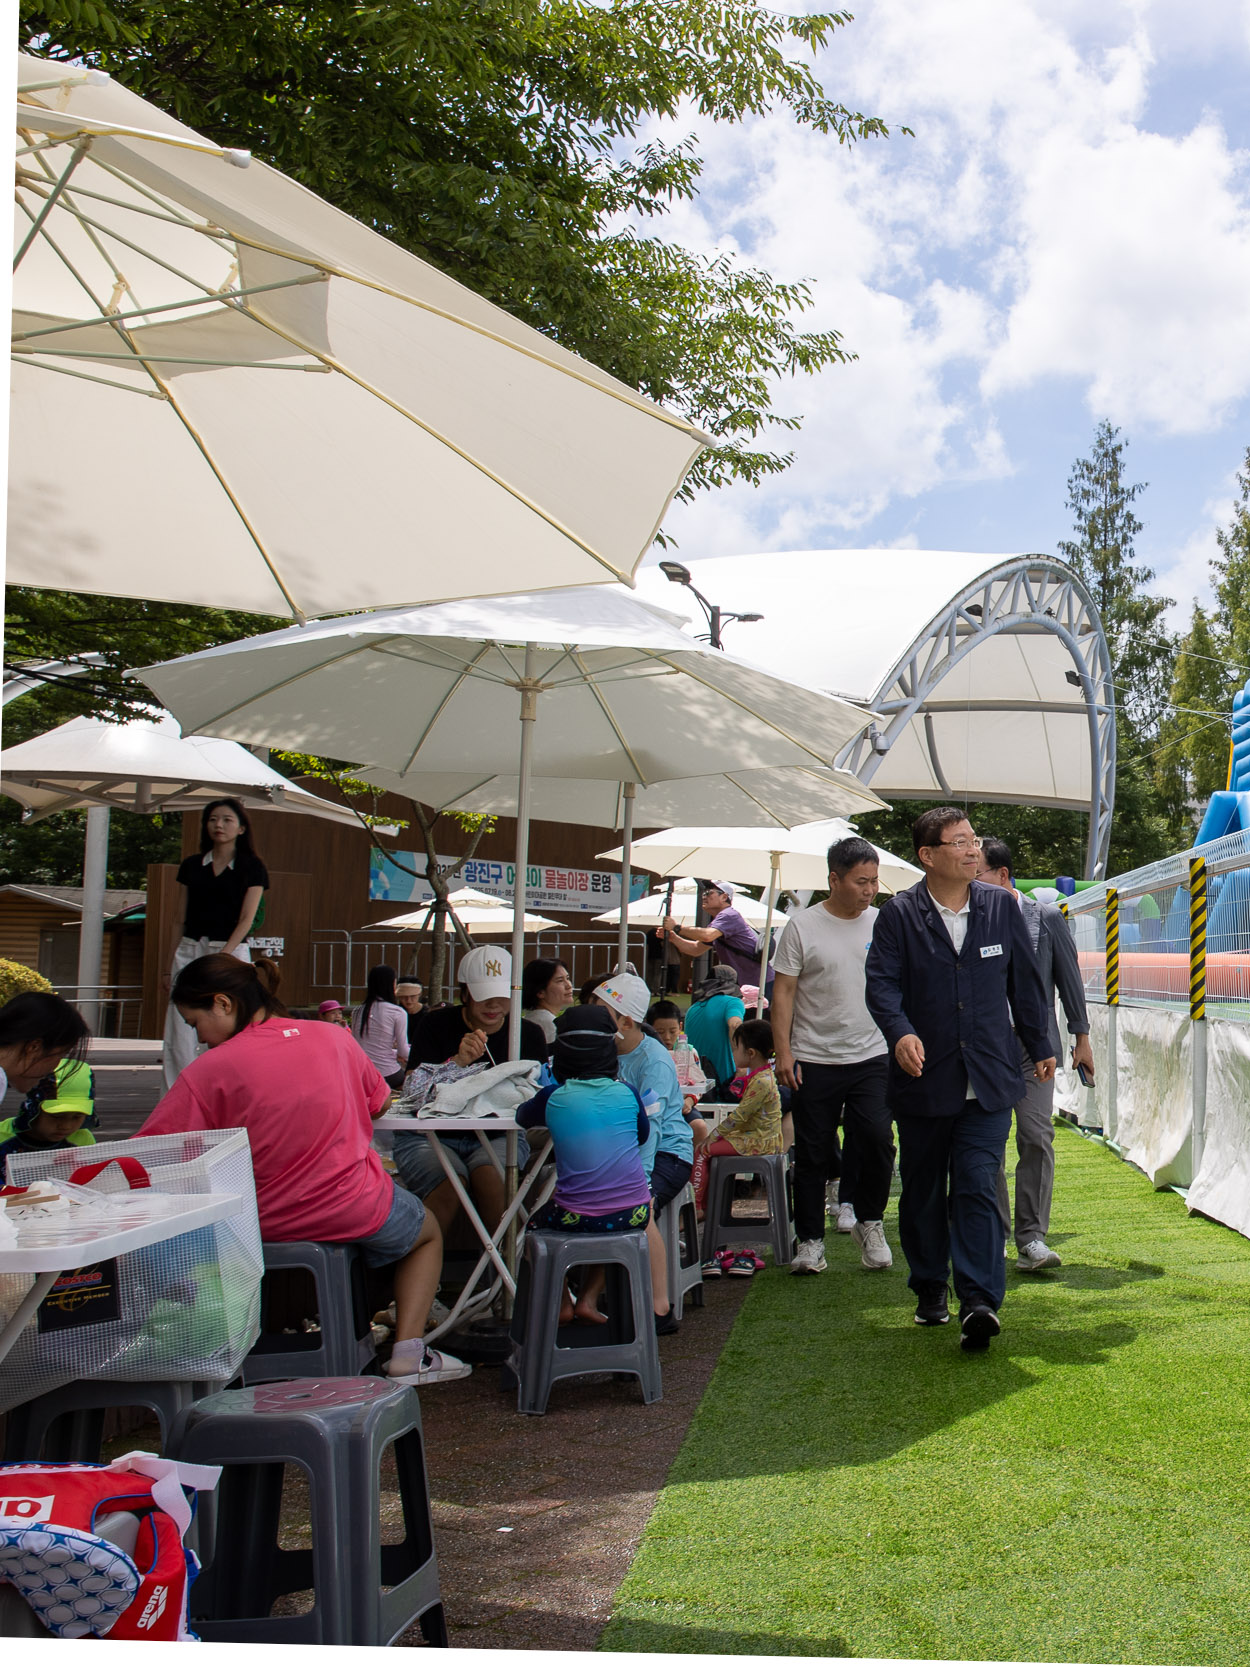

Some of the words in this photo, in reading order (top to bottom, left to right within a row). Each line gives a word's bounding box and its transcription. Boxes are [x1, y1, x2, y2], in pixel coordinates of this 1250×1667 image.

[465, 861, 503, 884] 광진구
[545, 869, 589, 891] 물놀이장
[591, 873, 611, 893] 운영
[485, 959, 502, 977] NY
[54, 1272, 103, 1287] COSTCO
[137, 1585, 163, 1629] arena
